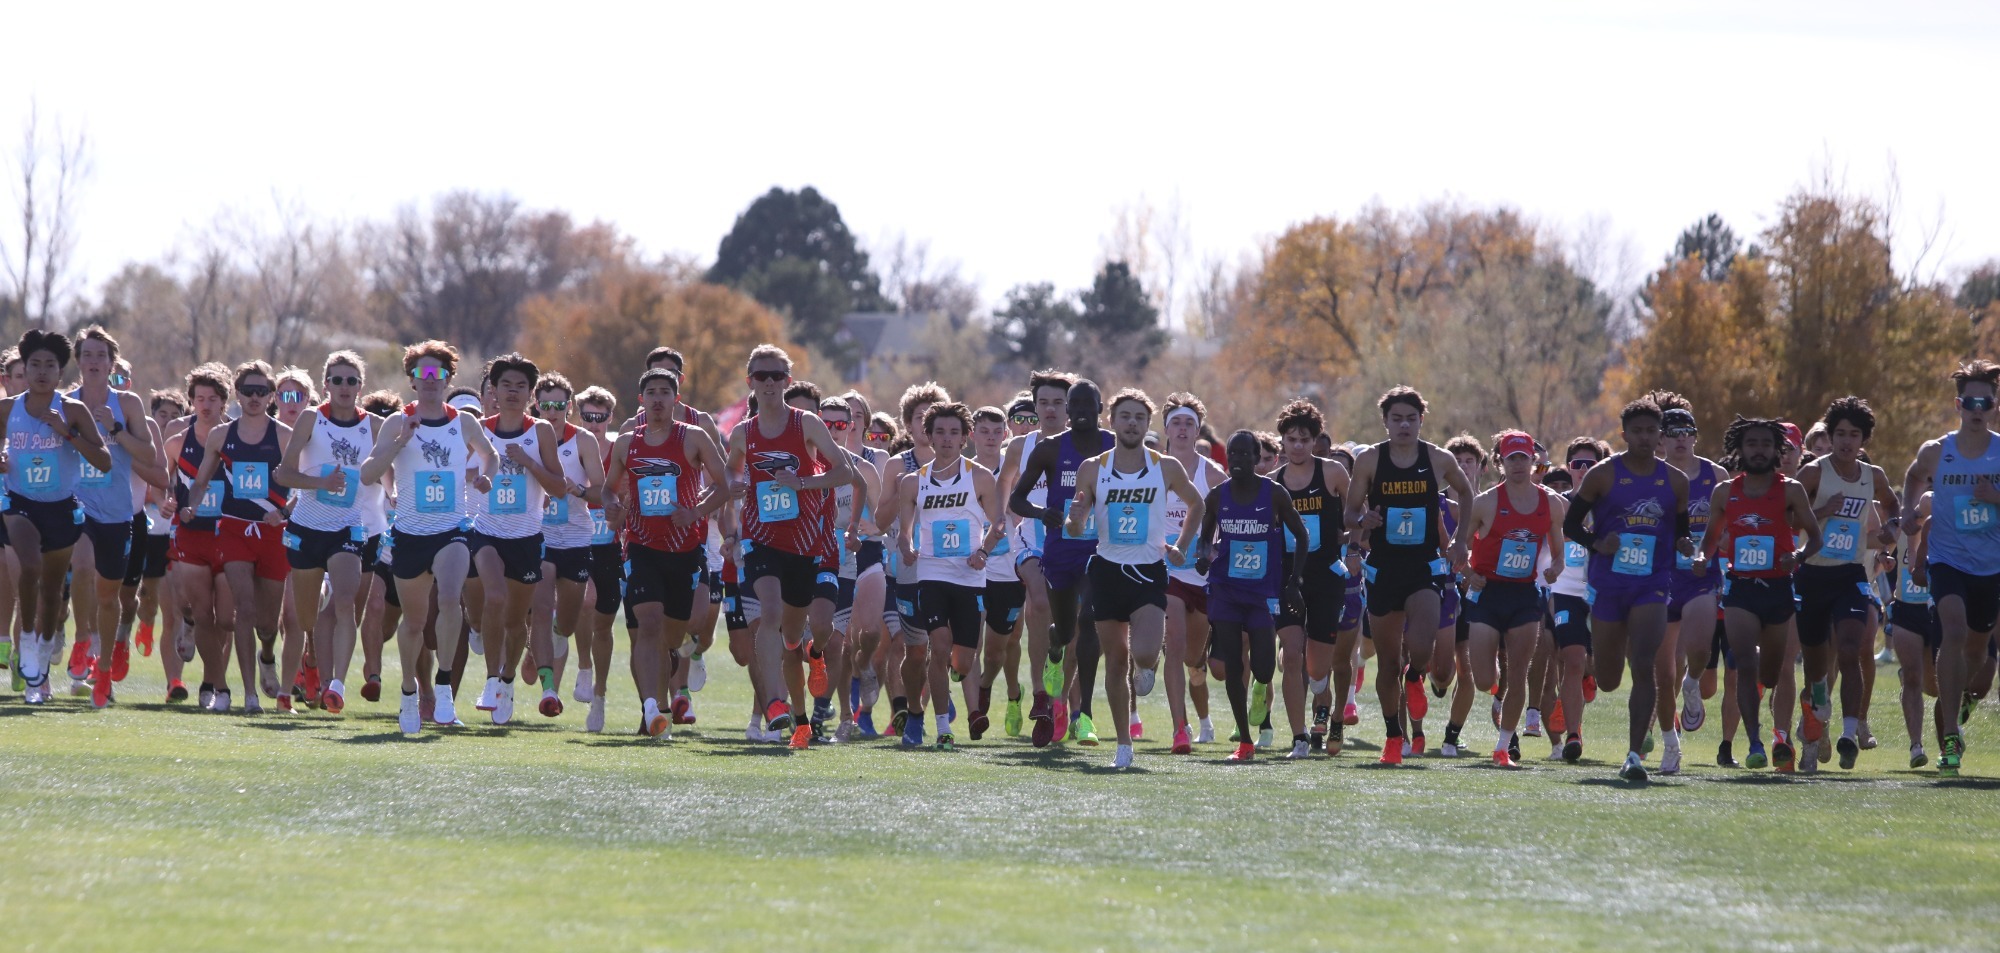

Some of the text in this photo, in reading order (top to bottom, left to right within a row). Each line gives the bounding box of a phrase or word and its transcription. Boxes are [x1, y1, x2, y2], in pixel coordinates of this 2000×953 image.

[31, 433, 64, 449] Pueblo
[25, 466, 51, 483] 127
[239, 474, 262, 490] 144
[1942, 474, 1967, 486] FORT
[425, 485, 445, 503] 96
[1382, 480, 1427, 495] CAMERON
[496, 488, 516, 505] 88
[643, 489, 671, 506] 378
[762, 492, 791, 511] 376
[922, 491, 969, 510] BHSU
[1104, 487, 1158, 506] BHSU
[1165, 509, 1187, 518] HAD
[1834, 496, 1867, 519] EU
[1961, 507, 1990, 525] 164
[1118, 516, 1138, 534] 22
[1220, 522, 1269, 535] HIGHLANDS
[1397, 520, 1414, 536] 41
[942, 532, 960, 549] 20
[1826, 532, 1854, 551] 280
[1234, 553, 1262, 570] 223
[1503, 552, 1531, 570] 206
[1620, 546, 1648, 566] 396
[1739, 548, 1767, 565] 209
